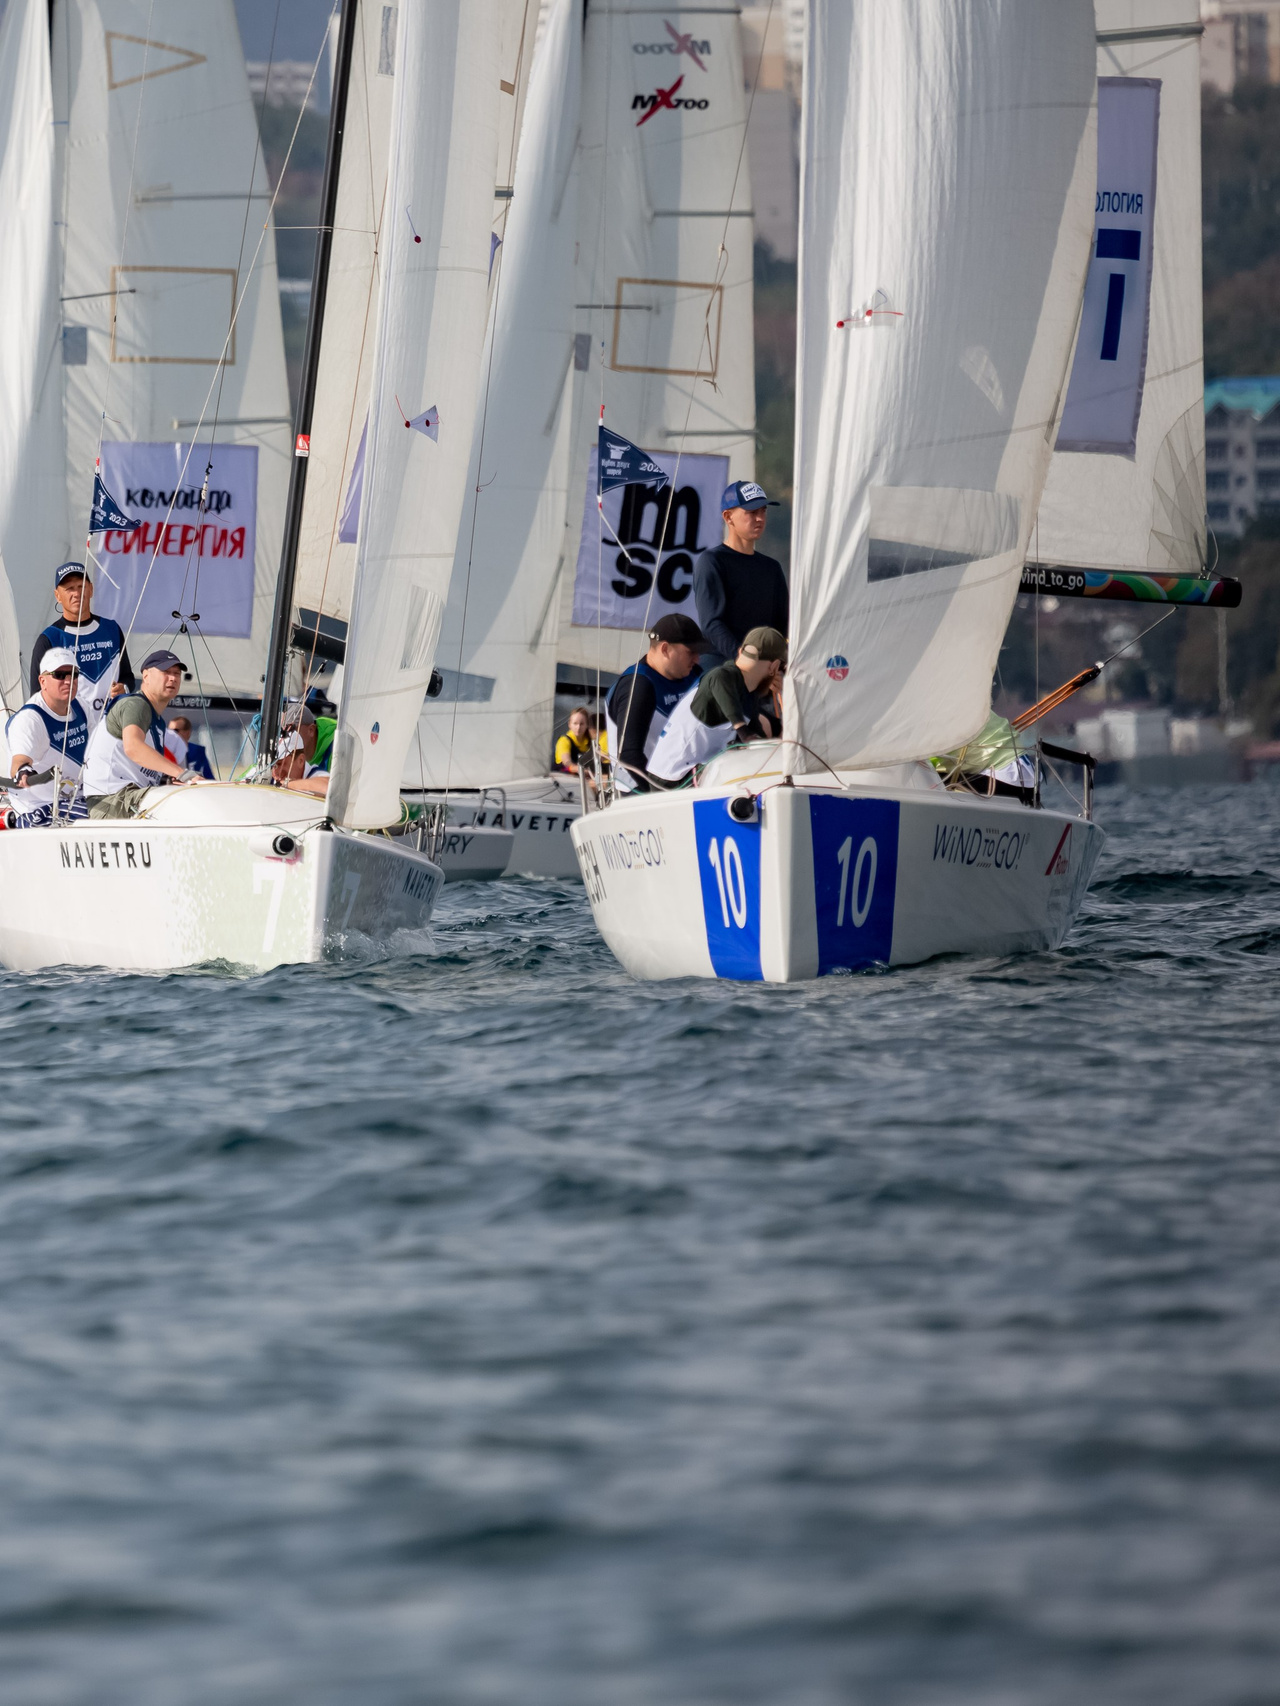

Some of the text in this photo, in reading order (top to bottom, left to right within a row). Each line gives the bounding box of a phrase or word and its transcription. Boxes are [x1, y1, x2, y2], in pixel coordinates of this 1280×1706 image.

[80, 652, 103, 662] 2023
[61, 841, 152, 869] NAVETRU
[708, 835, 747, 929] 10
[837, 836, 878, 928] 10
[252, 862, 286, 953] 7
